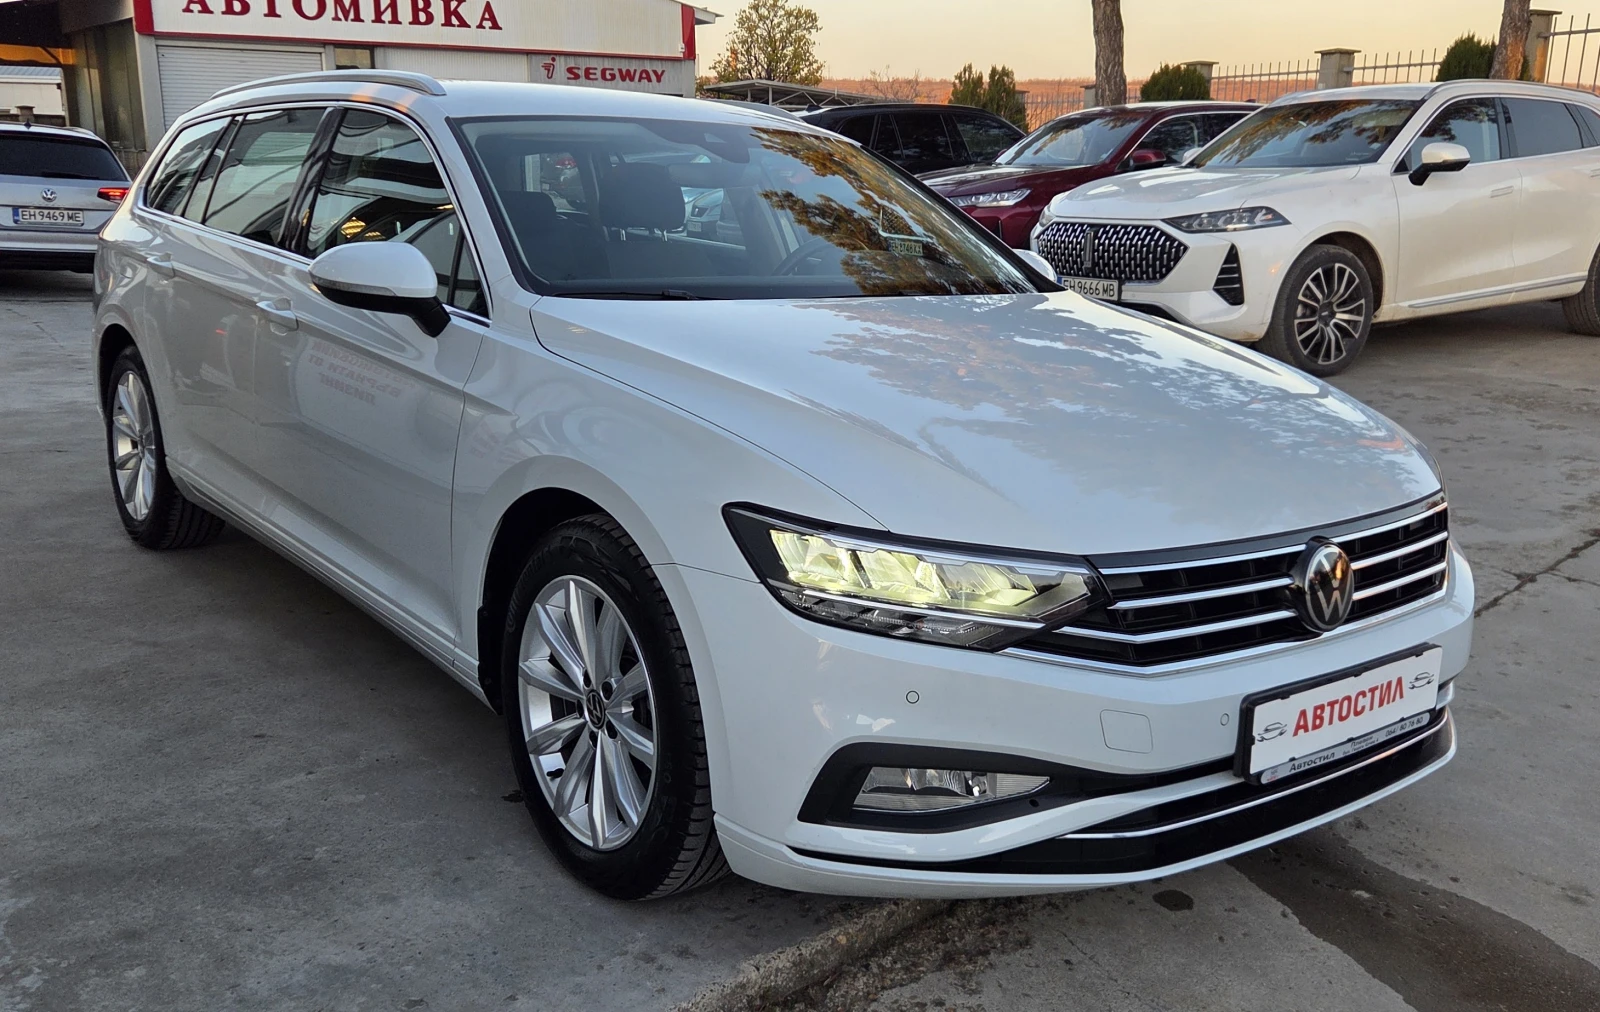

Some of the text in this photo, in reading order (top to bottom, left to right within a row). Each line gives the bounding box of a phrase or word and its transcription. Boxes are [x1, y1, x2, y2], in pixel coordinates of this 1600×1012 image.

[566, 66, 665, 83] SEGWAY
[21, 210, 82, 222] EH 9469 ME
[1077, 280, 1101, 296] 9666
[1102, 282, 1115, 298] MB
[1292, 676, 1404, 737] АВТОСТИЛ
[1289, 751, 1336, 773] Автостил
